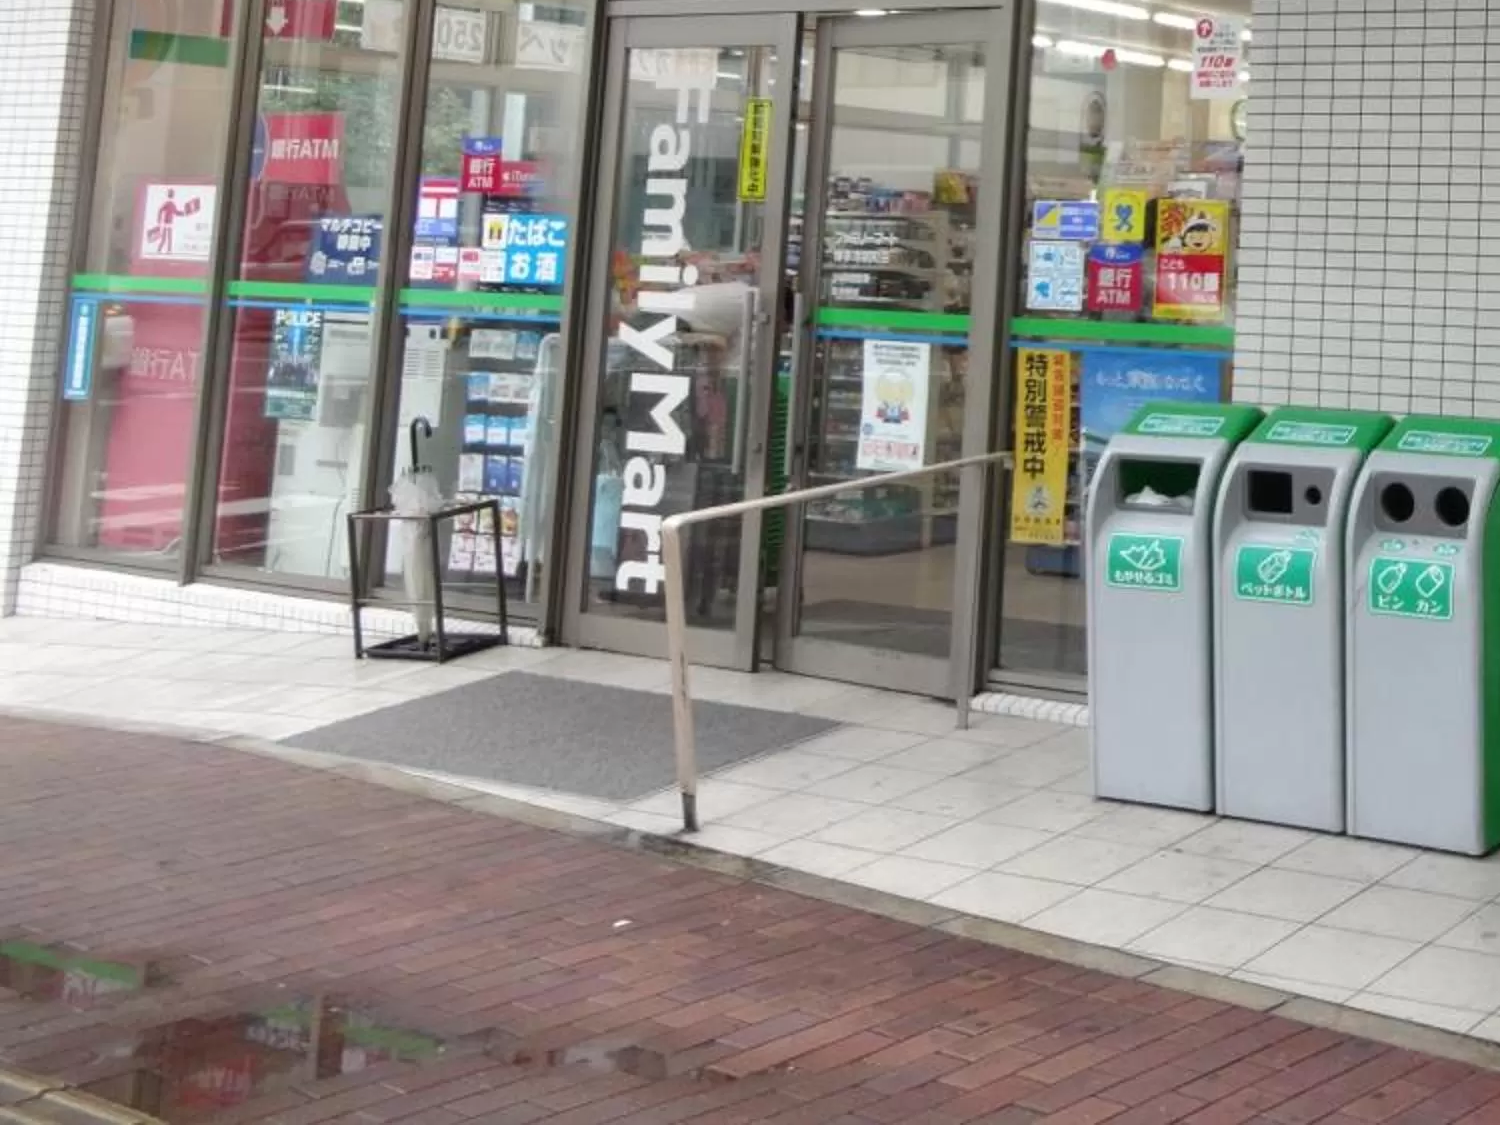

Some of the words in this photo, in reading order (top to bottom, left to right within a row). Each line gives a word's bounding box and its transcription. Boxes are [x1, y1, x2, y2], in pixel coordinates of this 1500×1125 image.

[468, 176, 494, 189] ATM
[508, 218, 567, 247] たばこ
[1096, 289, 1131, 305] ATM
[615, 71, 717, 594] FamilyMart
[1023, 352, 1048, 480] 特別警戒中
[1240, 582, 1307, 599] ペットボトル
[1378, 594, 1405, 610] ビン
[1415, 598, 1443, 613] カン
